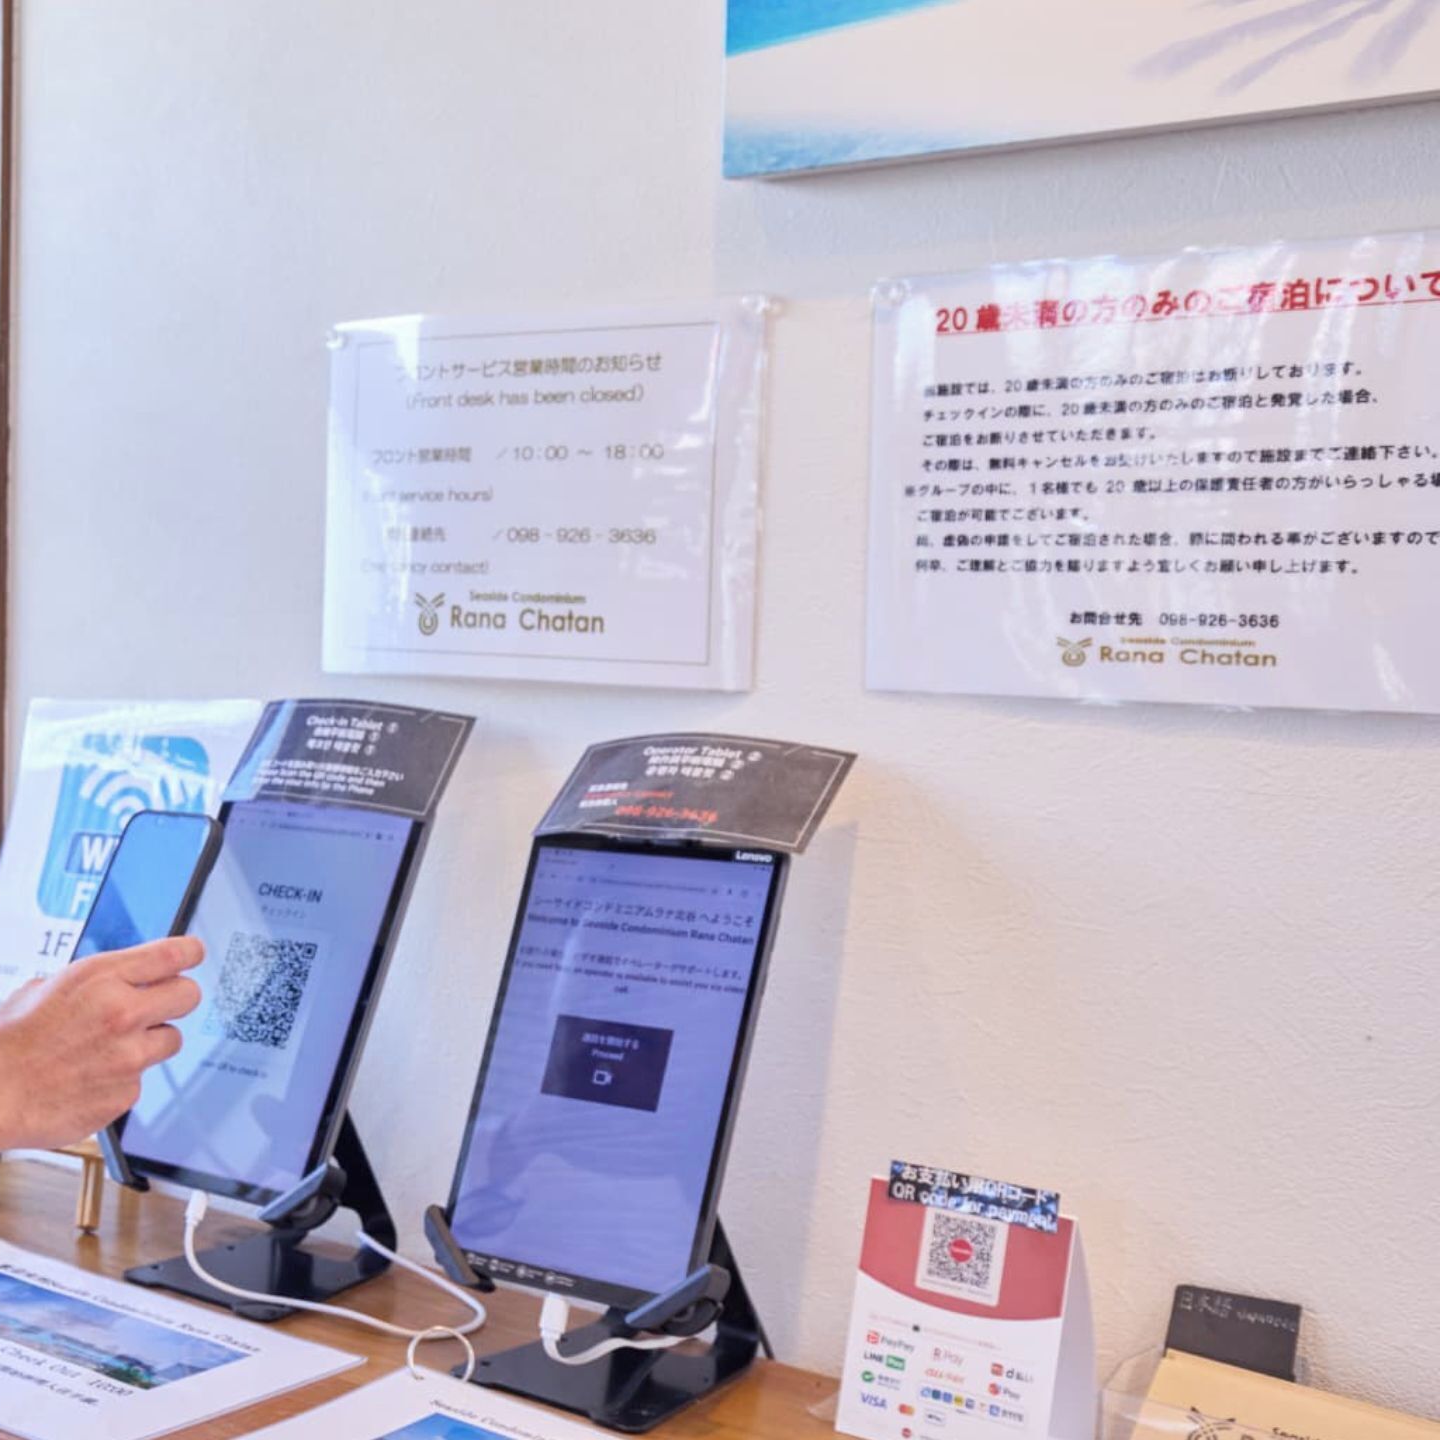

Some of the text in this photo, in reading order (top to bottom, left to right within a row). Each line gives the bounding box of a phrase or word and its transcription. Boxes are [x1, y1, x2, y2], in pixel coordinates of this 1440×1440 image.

[460, 389, 495, 405] desk
[500, 387, 529, 404] has
[534, 386, 575, 403] been
[580, 383, 644, 402] closed)
[469, 590, 587, 605] Seaside Condominium
[450, 605, 605, 634] Rana Chatan
[1099, 645, 1278, 668] Rana Chatan
[735, 850, 773, 862] Lenovo
[258, 882, 323, 903] CHECK-IN
[891, 1182, 917, 1201] QR
